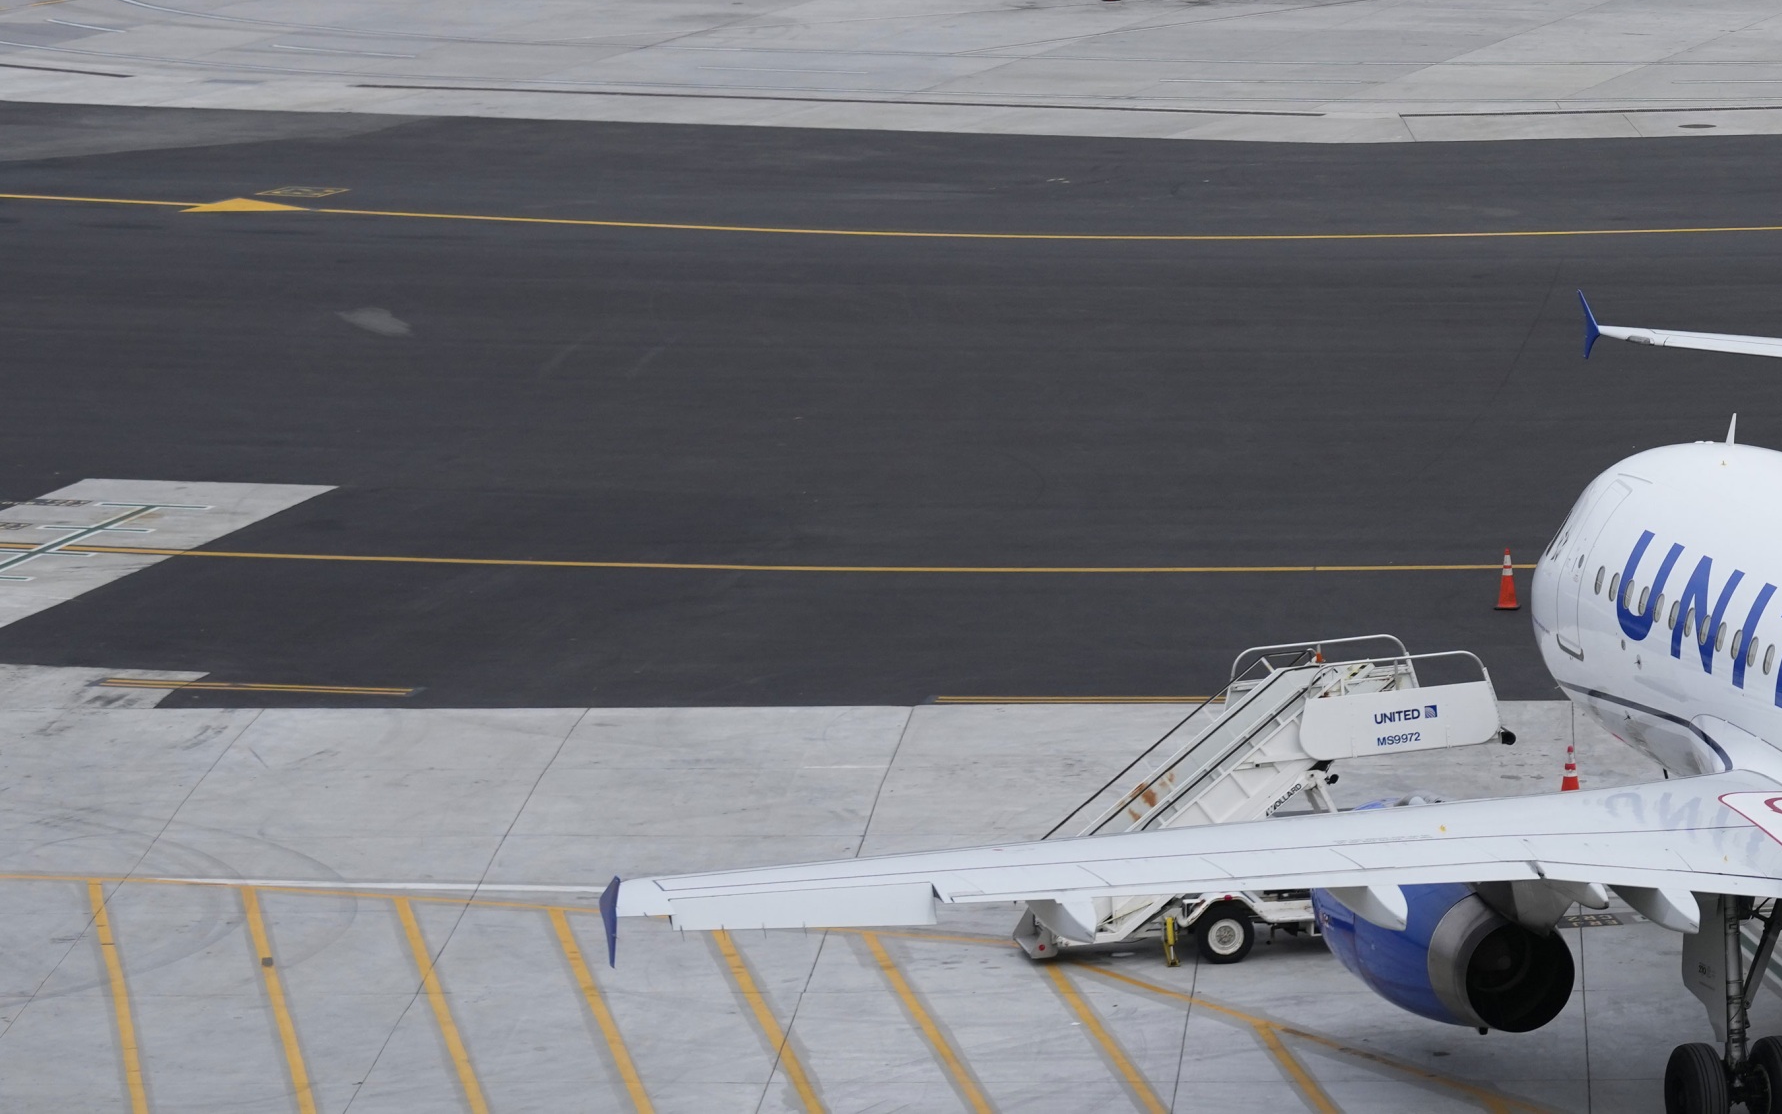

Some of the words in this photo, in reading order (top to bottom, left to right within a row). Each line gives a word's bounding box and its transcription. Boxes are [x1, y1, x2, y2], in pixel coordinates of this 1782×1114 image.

[1373, 707, 1421, 725] UNITED
[1376, 731, 1421, 748] MS9972
[1266, 783, 1302, 816] WOLLARD
